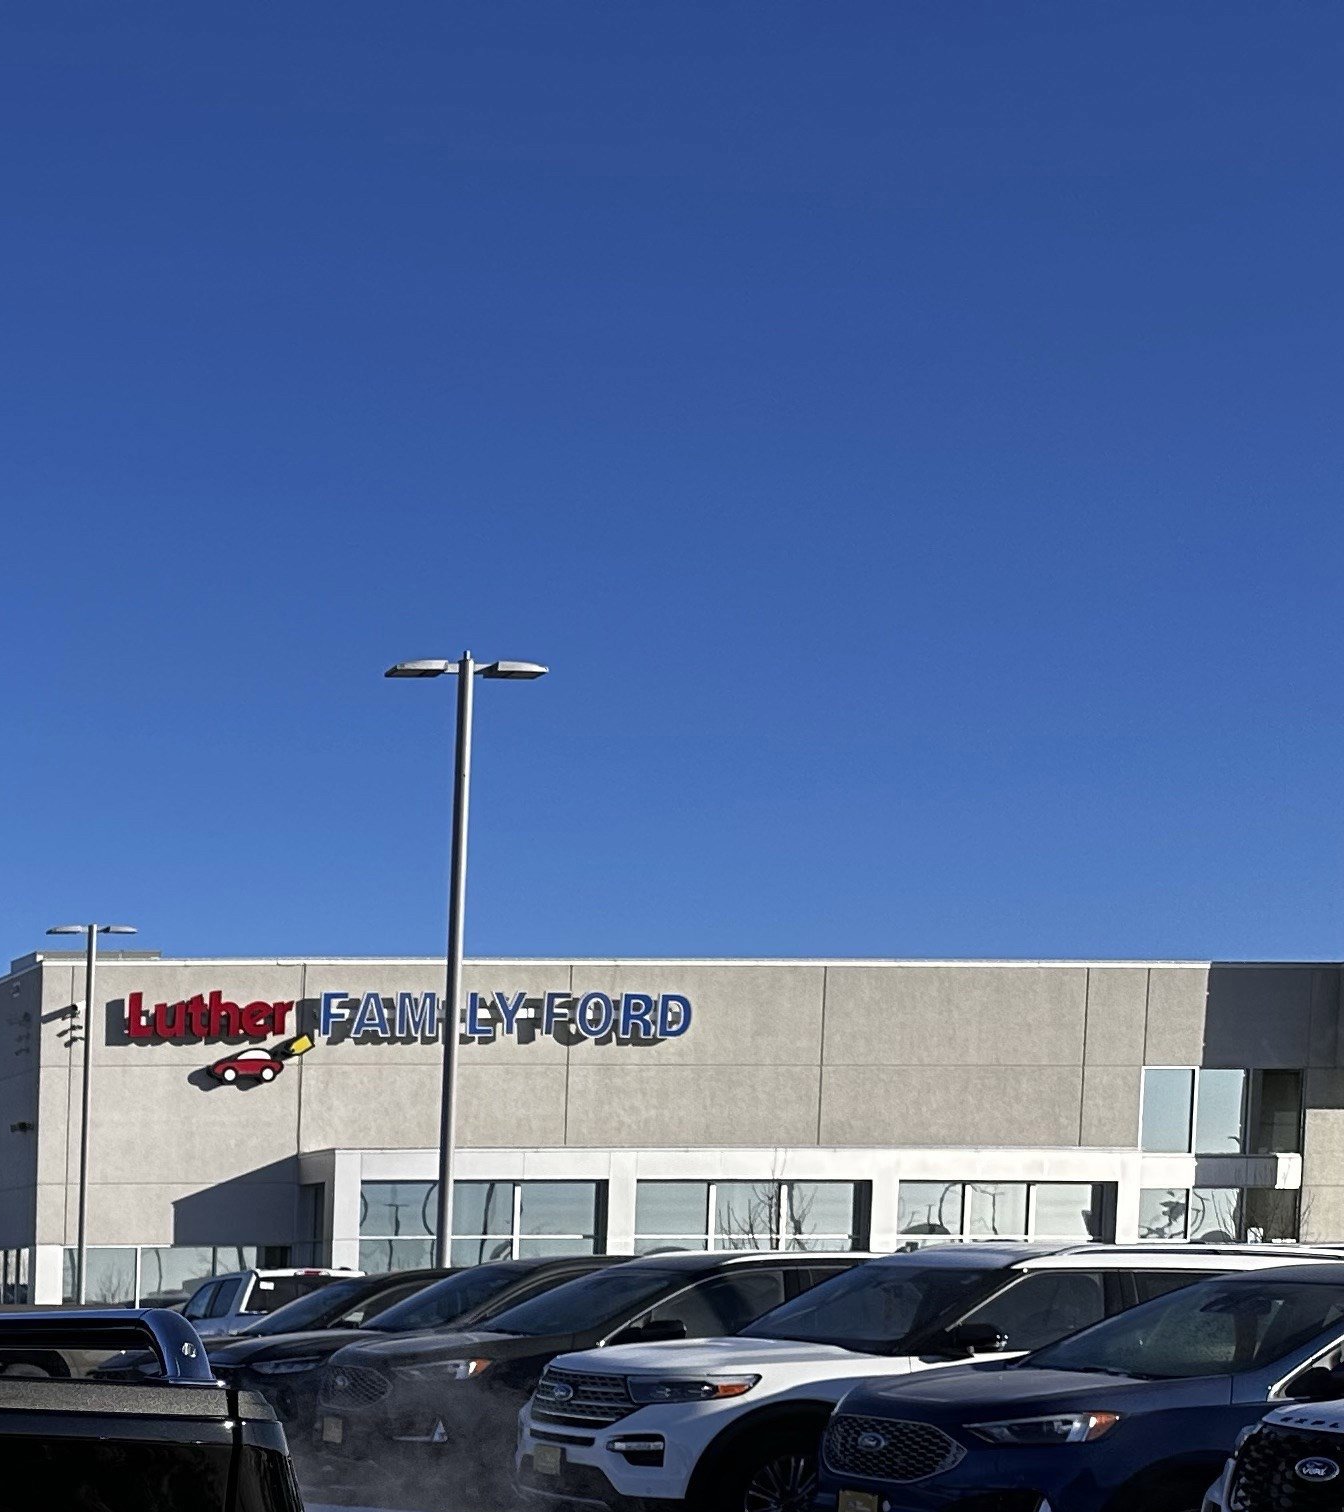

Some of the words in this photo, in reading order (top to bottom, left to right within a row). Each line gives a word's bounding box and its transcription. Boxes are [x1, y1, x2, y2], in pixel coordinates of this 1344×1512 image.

[128, 990, 295, 1037] Luther
[318, 991, 528, 1038] FAMLY
[541, 991, 693, 1039] FORD
